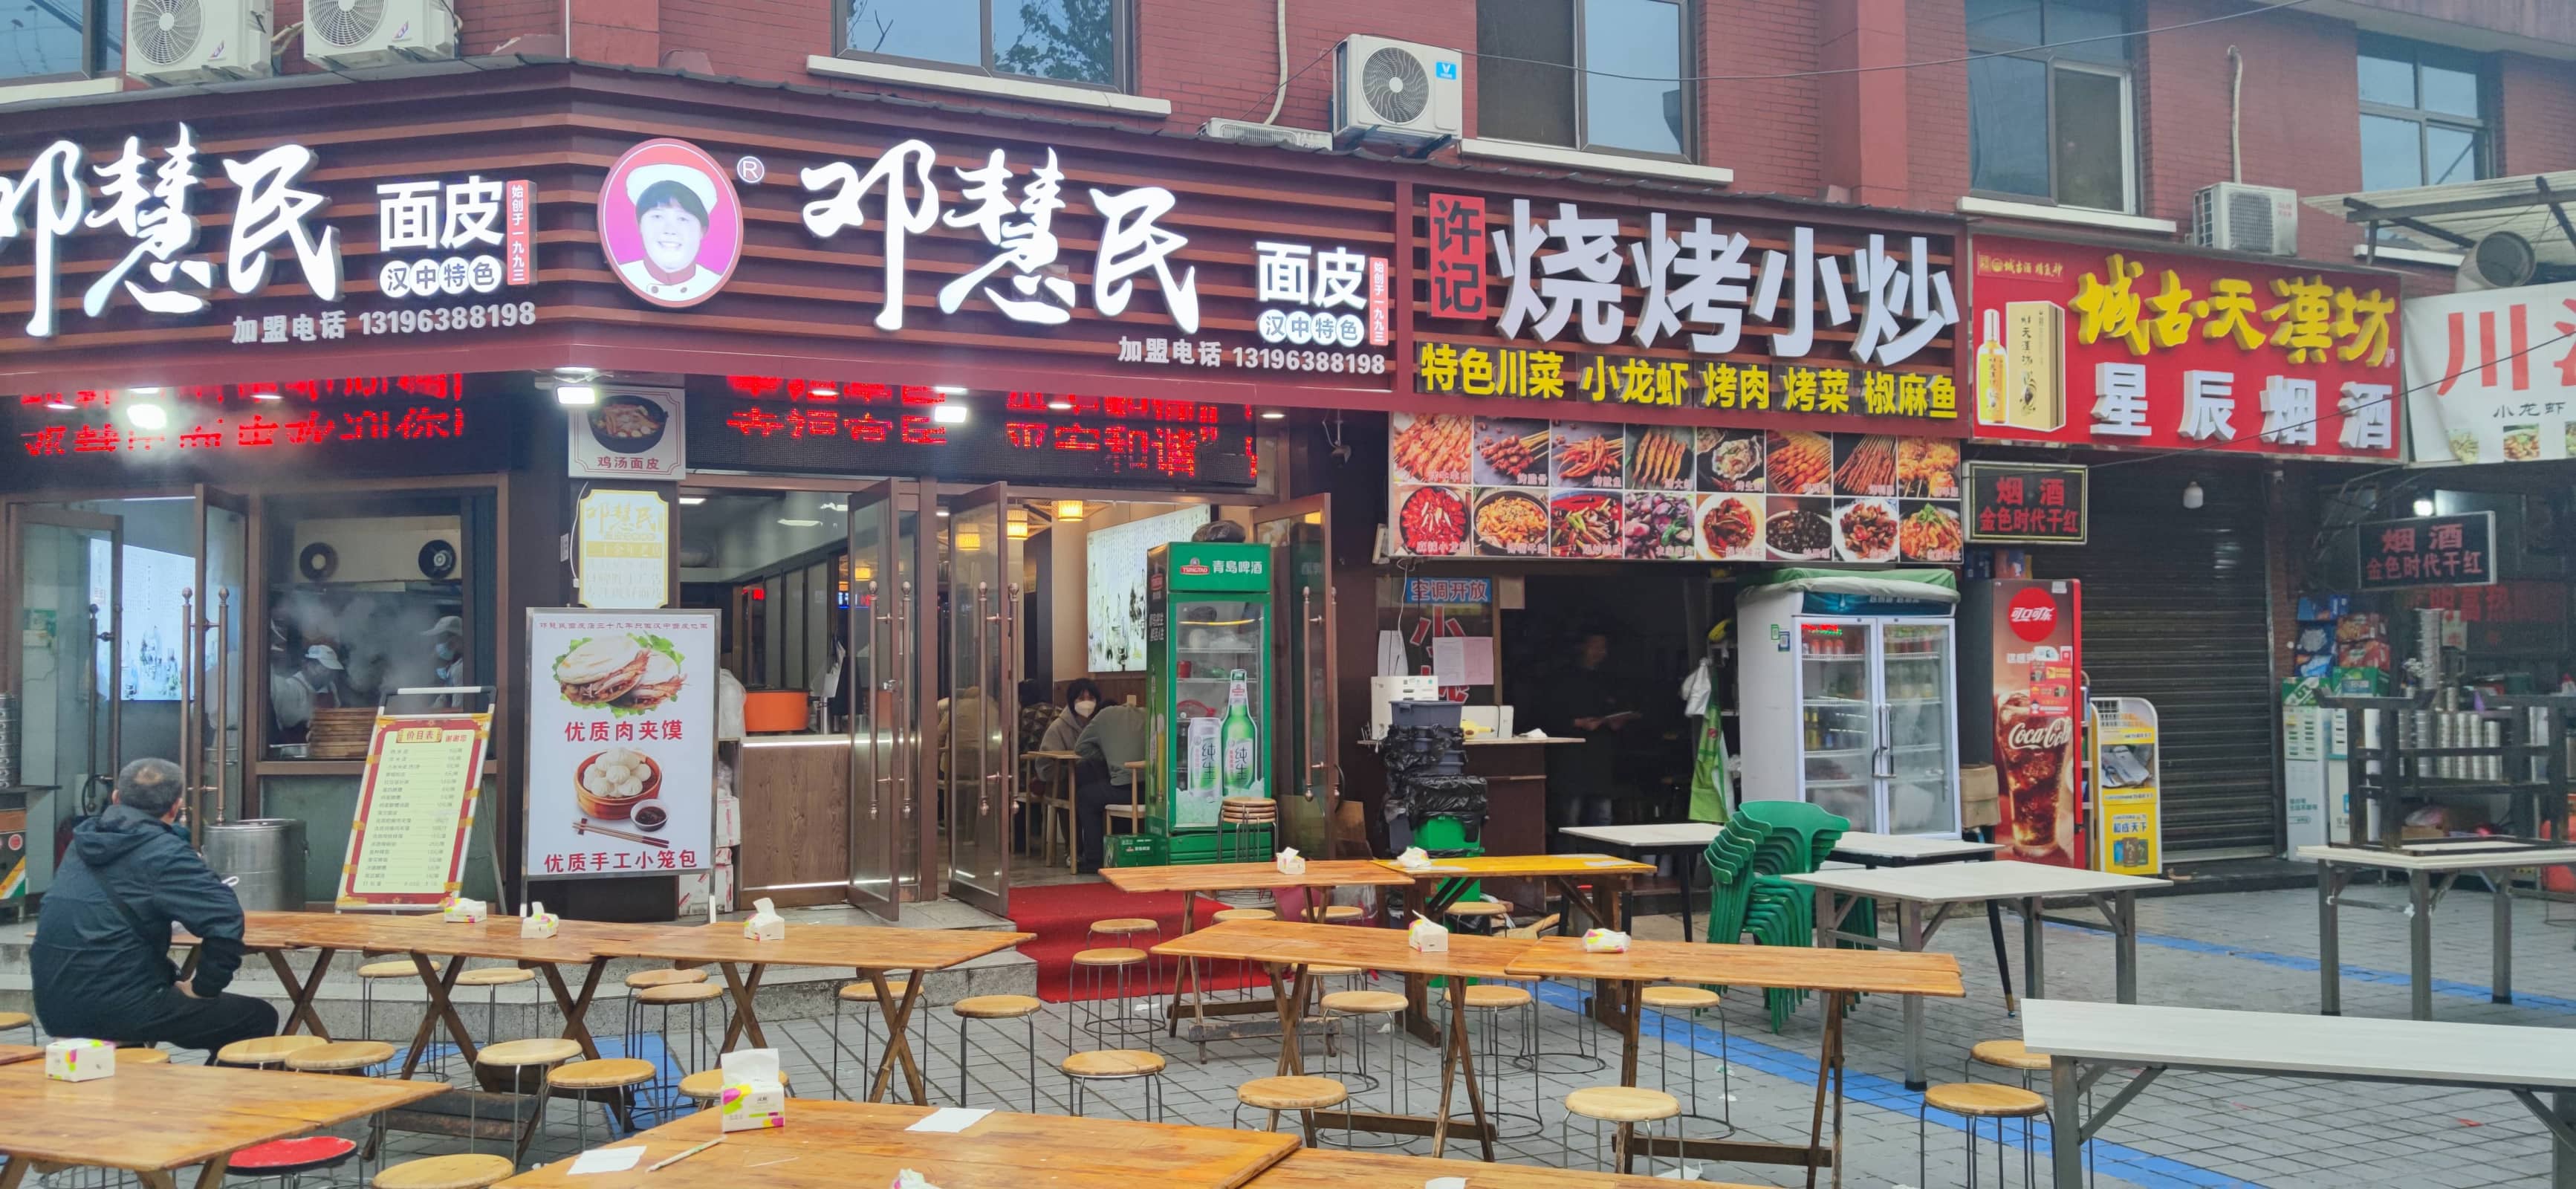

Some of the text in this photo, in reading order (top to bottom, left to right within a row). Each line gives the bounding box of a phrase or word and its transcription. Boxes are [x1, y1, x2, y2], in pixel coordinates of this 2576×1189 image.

[0, 121, 345, 338] 邓慧民
[377, 175, 506, 252] 面皮
[511, 184, 525, 282] 始创于一九九三
[799, 139, 1200, 334] 邓慧民
[1433, 199, 1483, 314] 许记
[386, 265, 502, 294] 汉中特色
[1256, 240, 1367, 310] 面皮
[1490, 198, 1960, 367] 烧烤小炒
[1374, 261, 1385, 343] 始创于一九九三
[232, 302, 536, 344] 加盟电话 13196388198
[1265, 314, 1360, 342] 汉中特色
[1117, 336, 1386, 375] 加盟电话 13196388198
[1420, 343, 1565, 399] 特色川菜
[1581, 357, 1690, 406] 小龙虾
[1702, 368, 1771, 412] 烤肉
[1782, 369, 1850, 415] 烤菜
[1863, 372, 1958, 420] 椒麻鱼
[2089, 361, 2394, 450] 星辰烟酒
[2492, 401, 2566, 418] 小龙虾
[597, 456, 660, 470] 鸡汤面皮
[1996, 476, 2066, 506] 烟酒
[1979, 506, 2079, 534] 金色时代干红
[2381, 523, 2463, 554] 烟酒
[2366, 549, 2483, 580] 金色时代干红
[1411, 580, 1488, 601] 空调开放
[2011, 607, 2055, 622] 可口可乐
[565, 719, 683, 742] 优质肉夹馍
[2008, 716, 2072, 750] Coca-Cola
[544, 849, 697, 872] 优质手工小笼包
